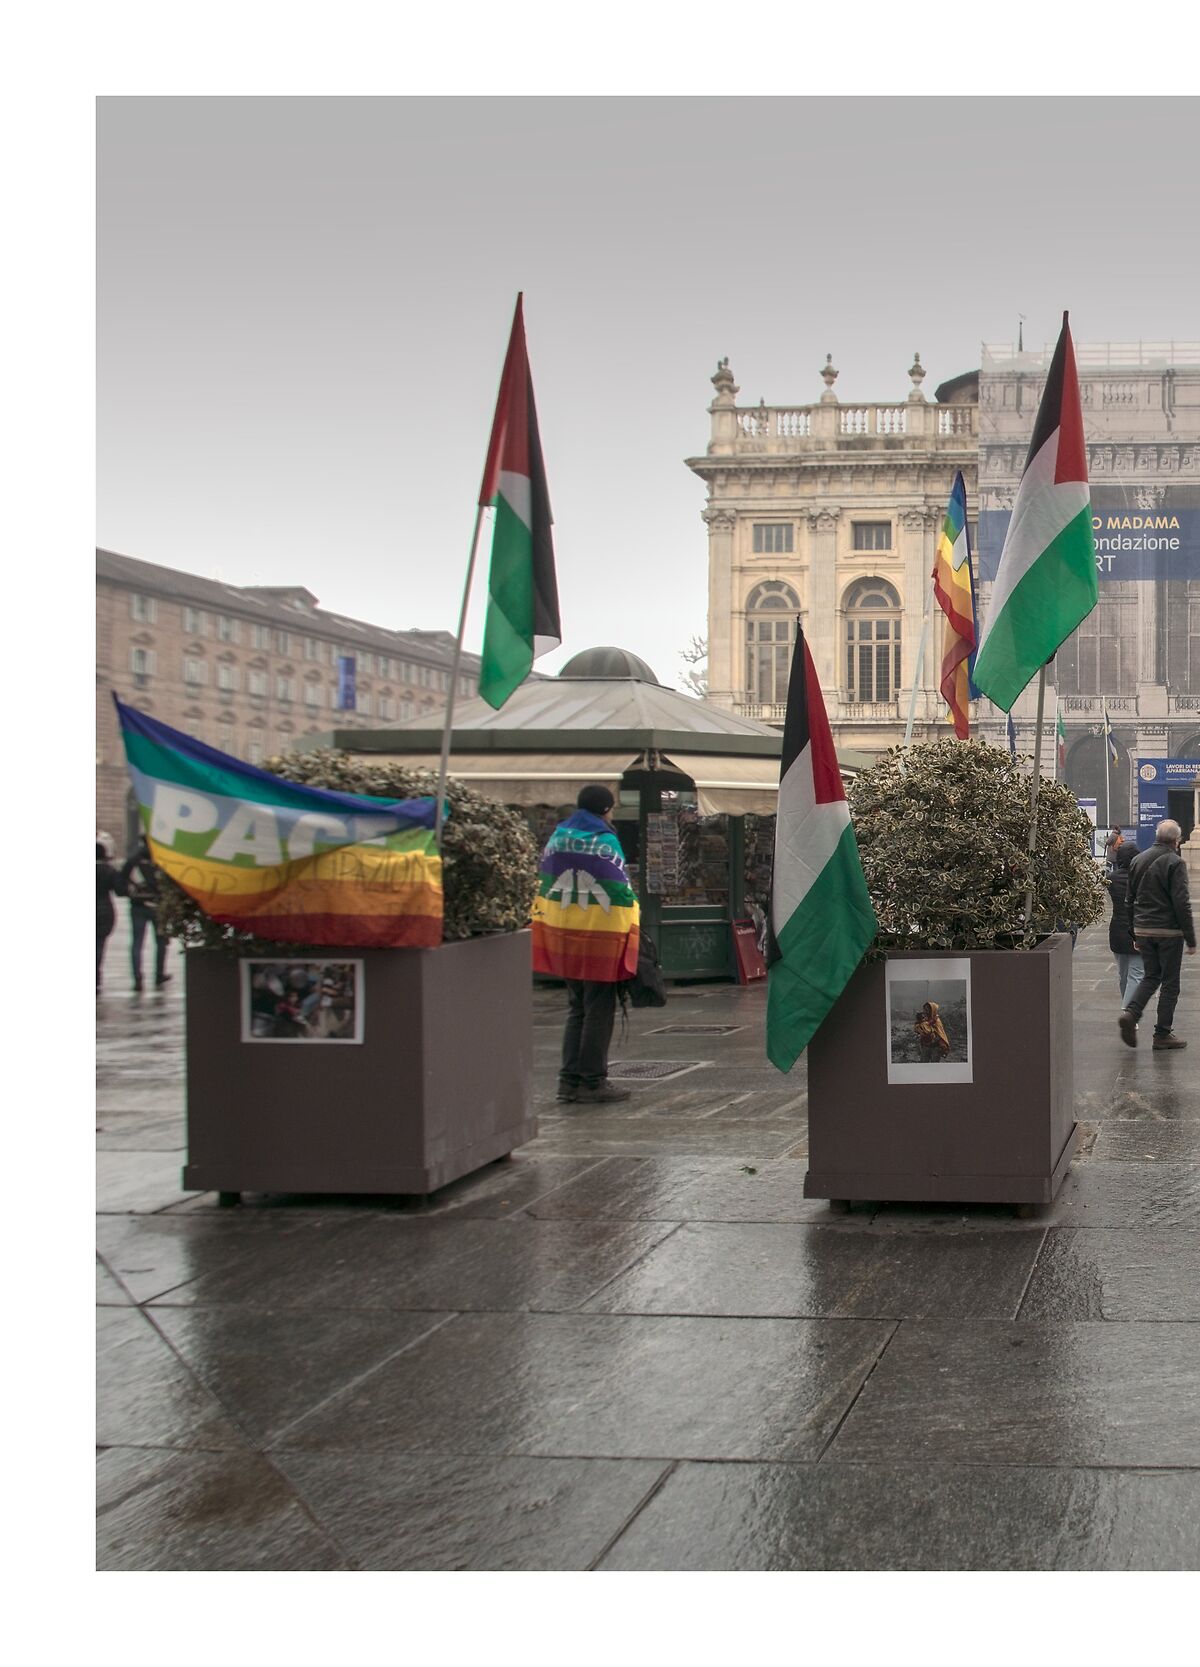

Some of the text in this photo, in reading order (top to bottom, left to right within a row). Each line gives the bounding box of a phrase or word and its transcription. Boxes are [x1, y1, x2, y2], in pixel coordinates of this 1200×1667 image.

[1092, 517, 1180, 529] O MADAMA
[1094, 534, 1180, 550] ndazione
[1095, 555, 1116, 572] RT
